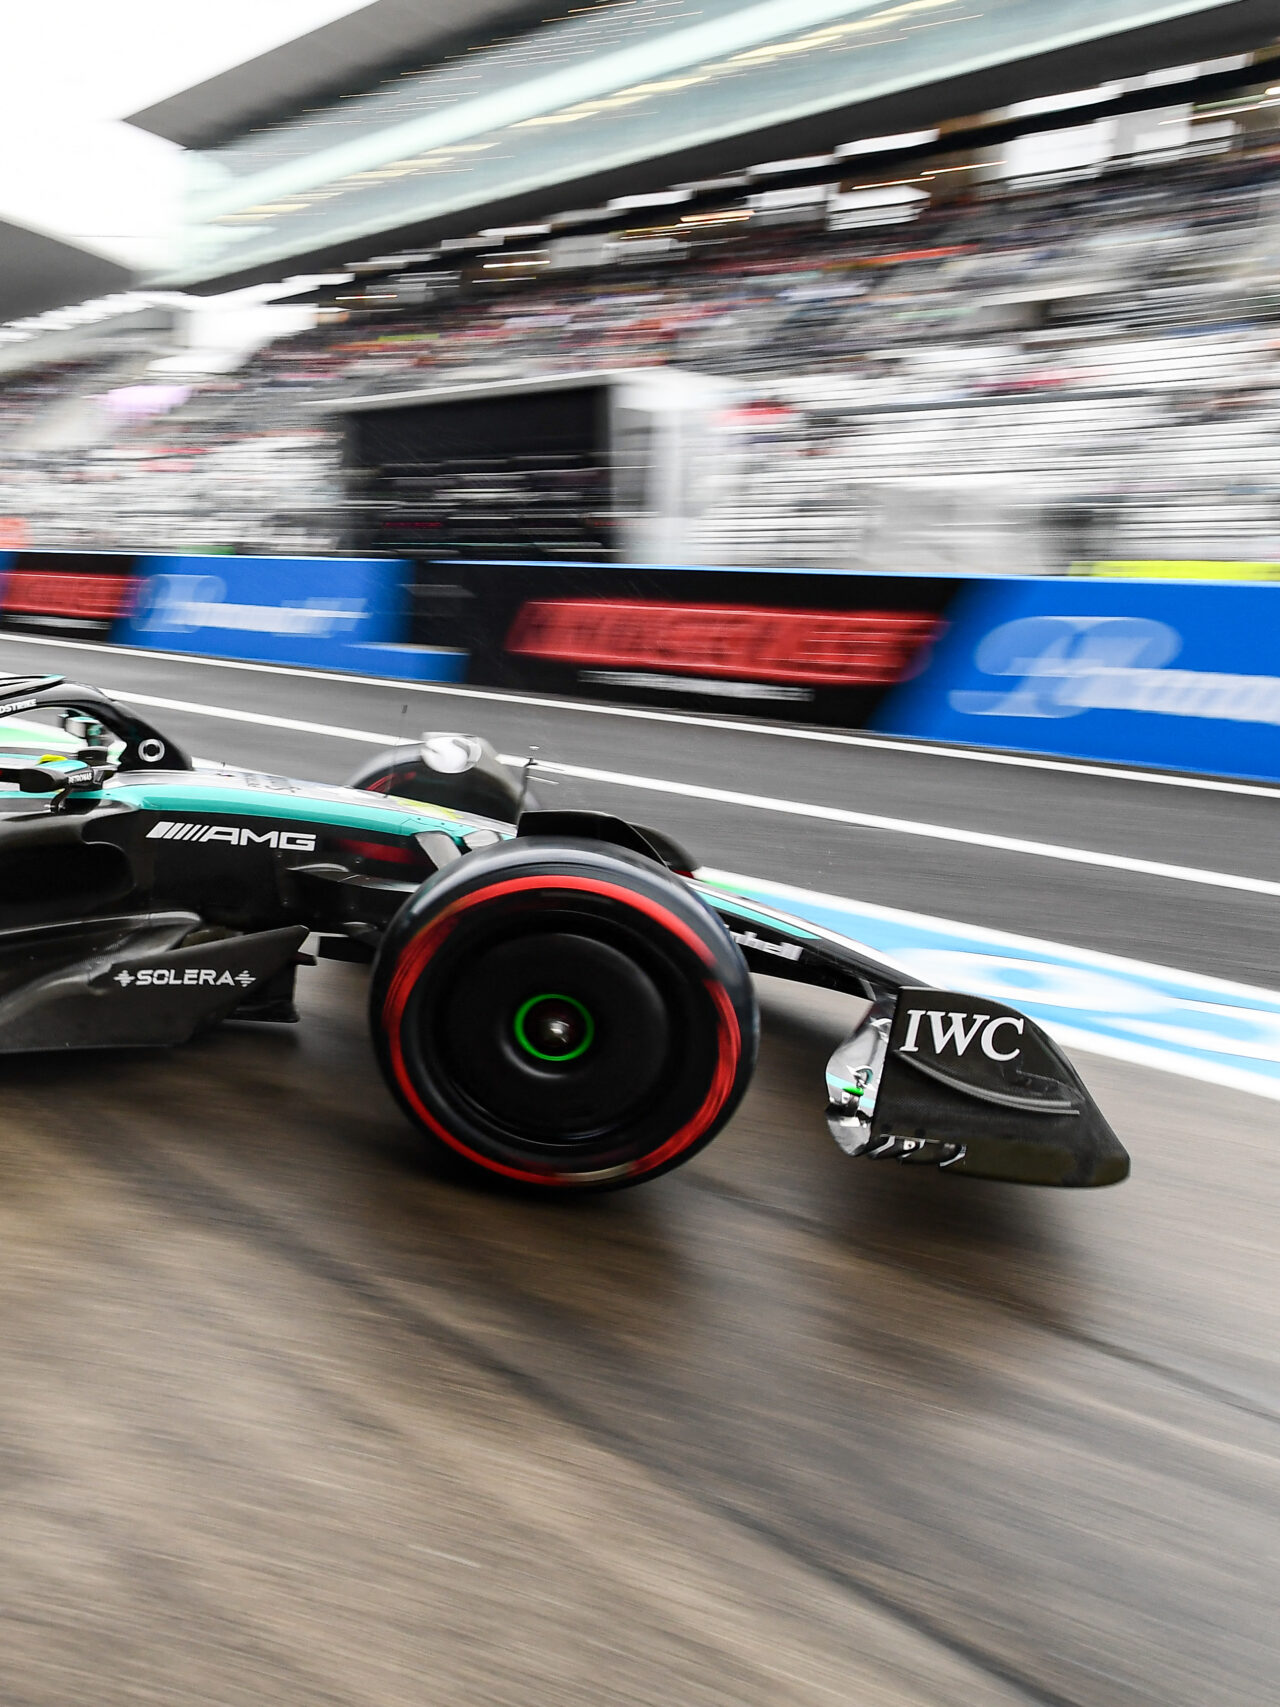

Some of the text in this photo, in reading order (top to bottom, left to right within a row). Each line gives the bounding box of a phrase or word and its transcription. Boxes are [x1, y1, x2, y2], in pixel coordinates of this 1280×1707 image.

[202, 825, 316, 852] AMG
[135, 968, 235, 986] SOLERA
[899, 1009, 1024, 1062] IWC
